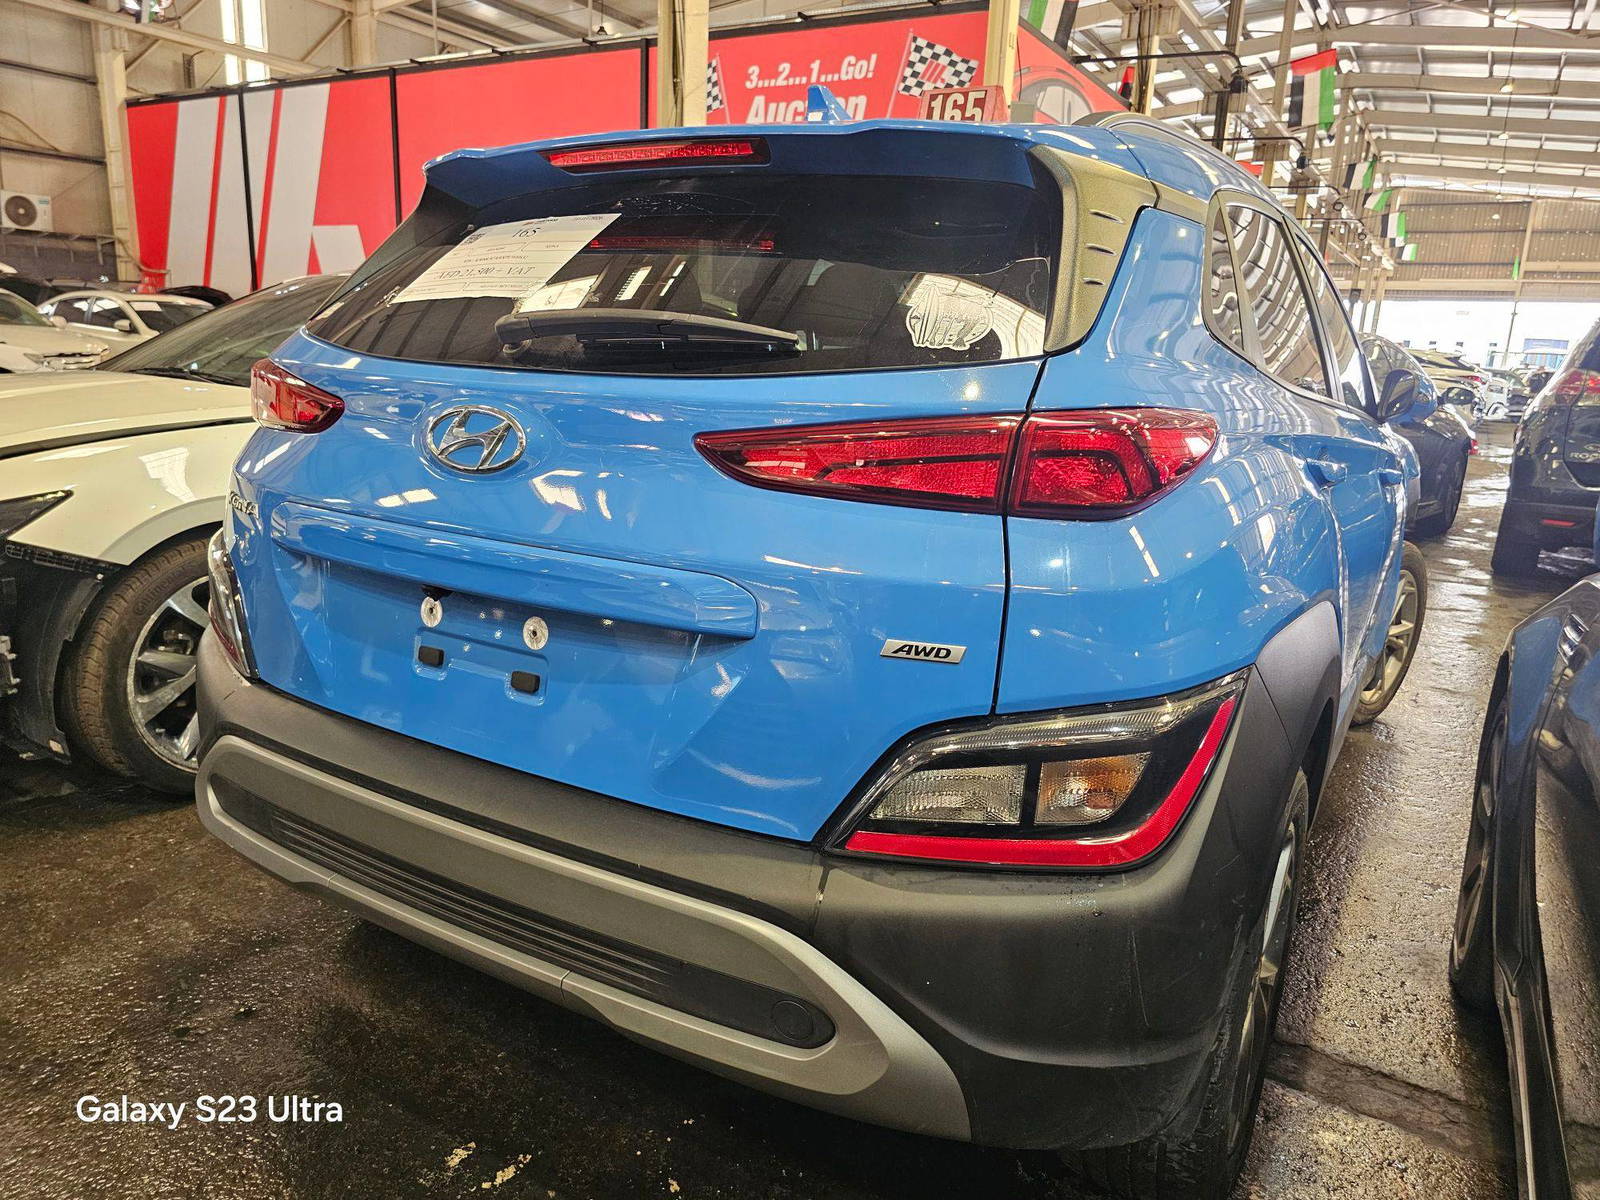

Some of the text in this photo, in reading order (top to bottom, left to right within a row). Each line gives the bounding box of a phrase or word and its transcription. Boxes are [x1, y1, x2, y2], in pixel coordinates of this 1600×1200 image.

[746, 95, 868, 124] Aucn
[930, 90, 987, 121] 165
[512, 227, 541, 238] 165
[507, 266, 536, 275] VAT
[891, 644, 952, 659] AWD
